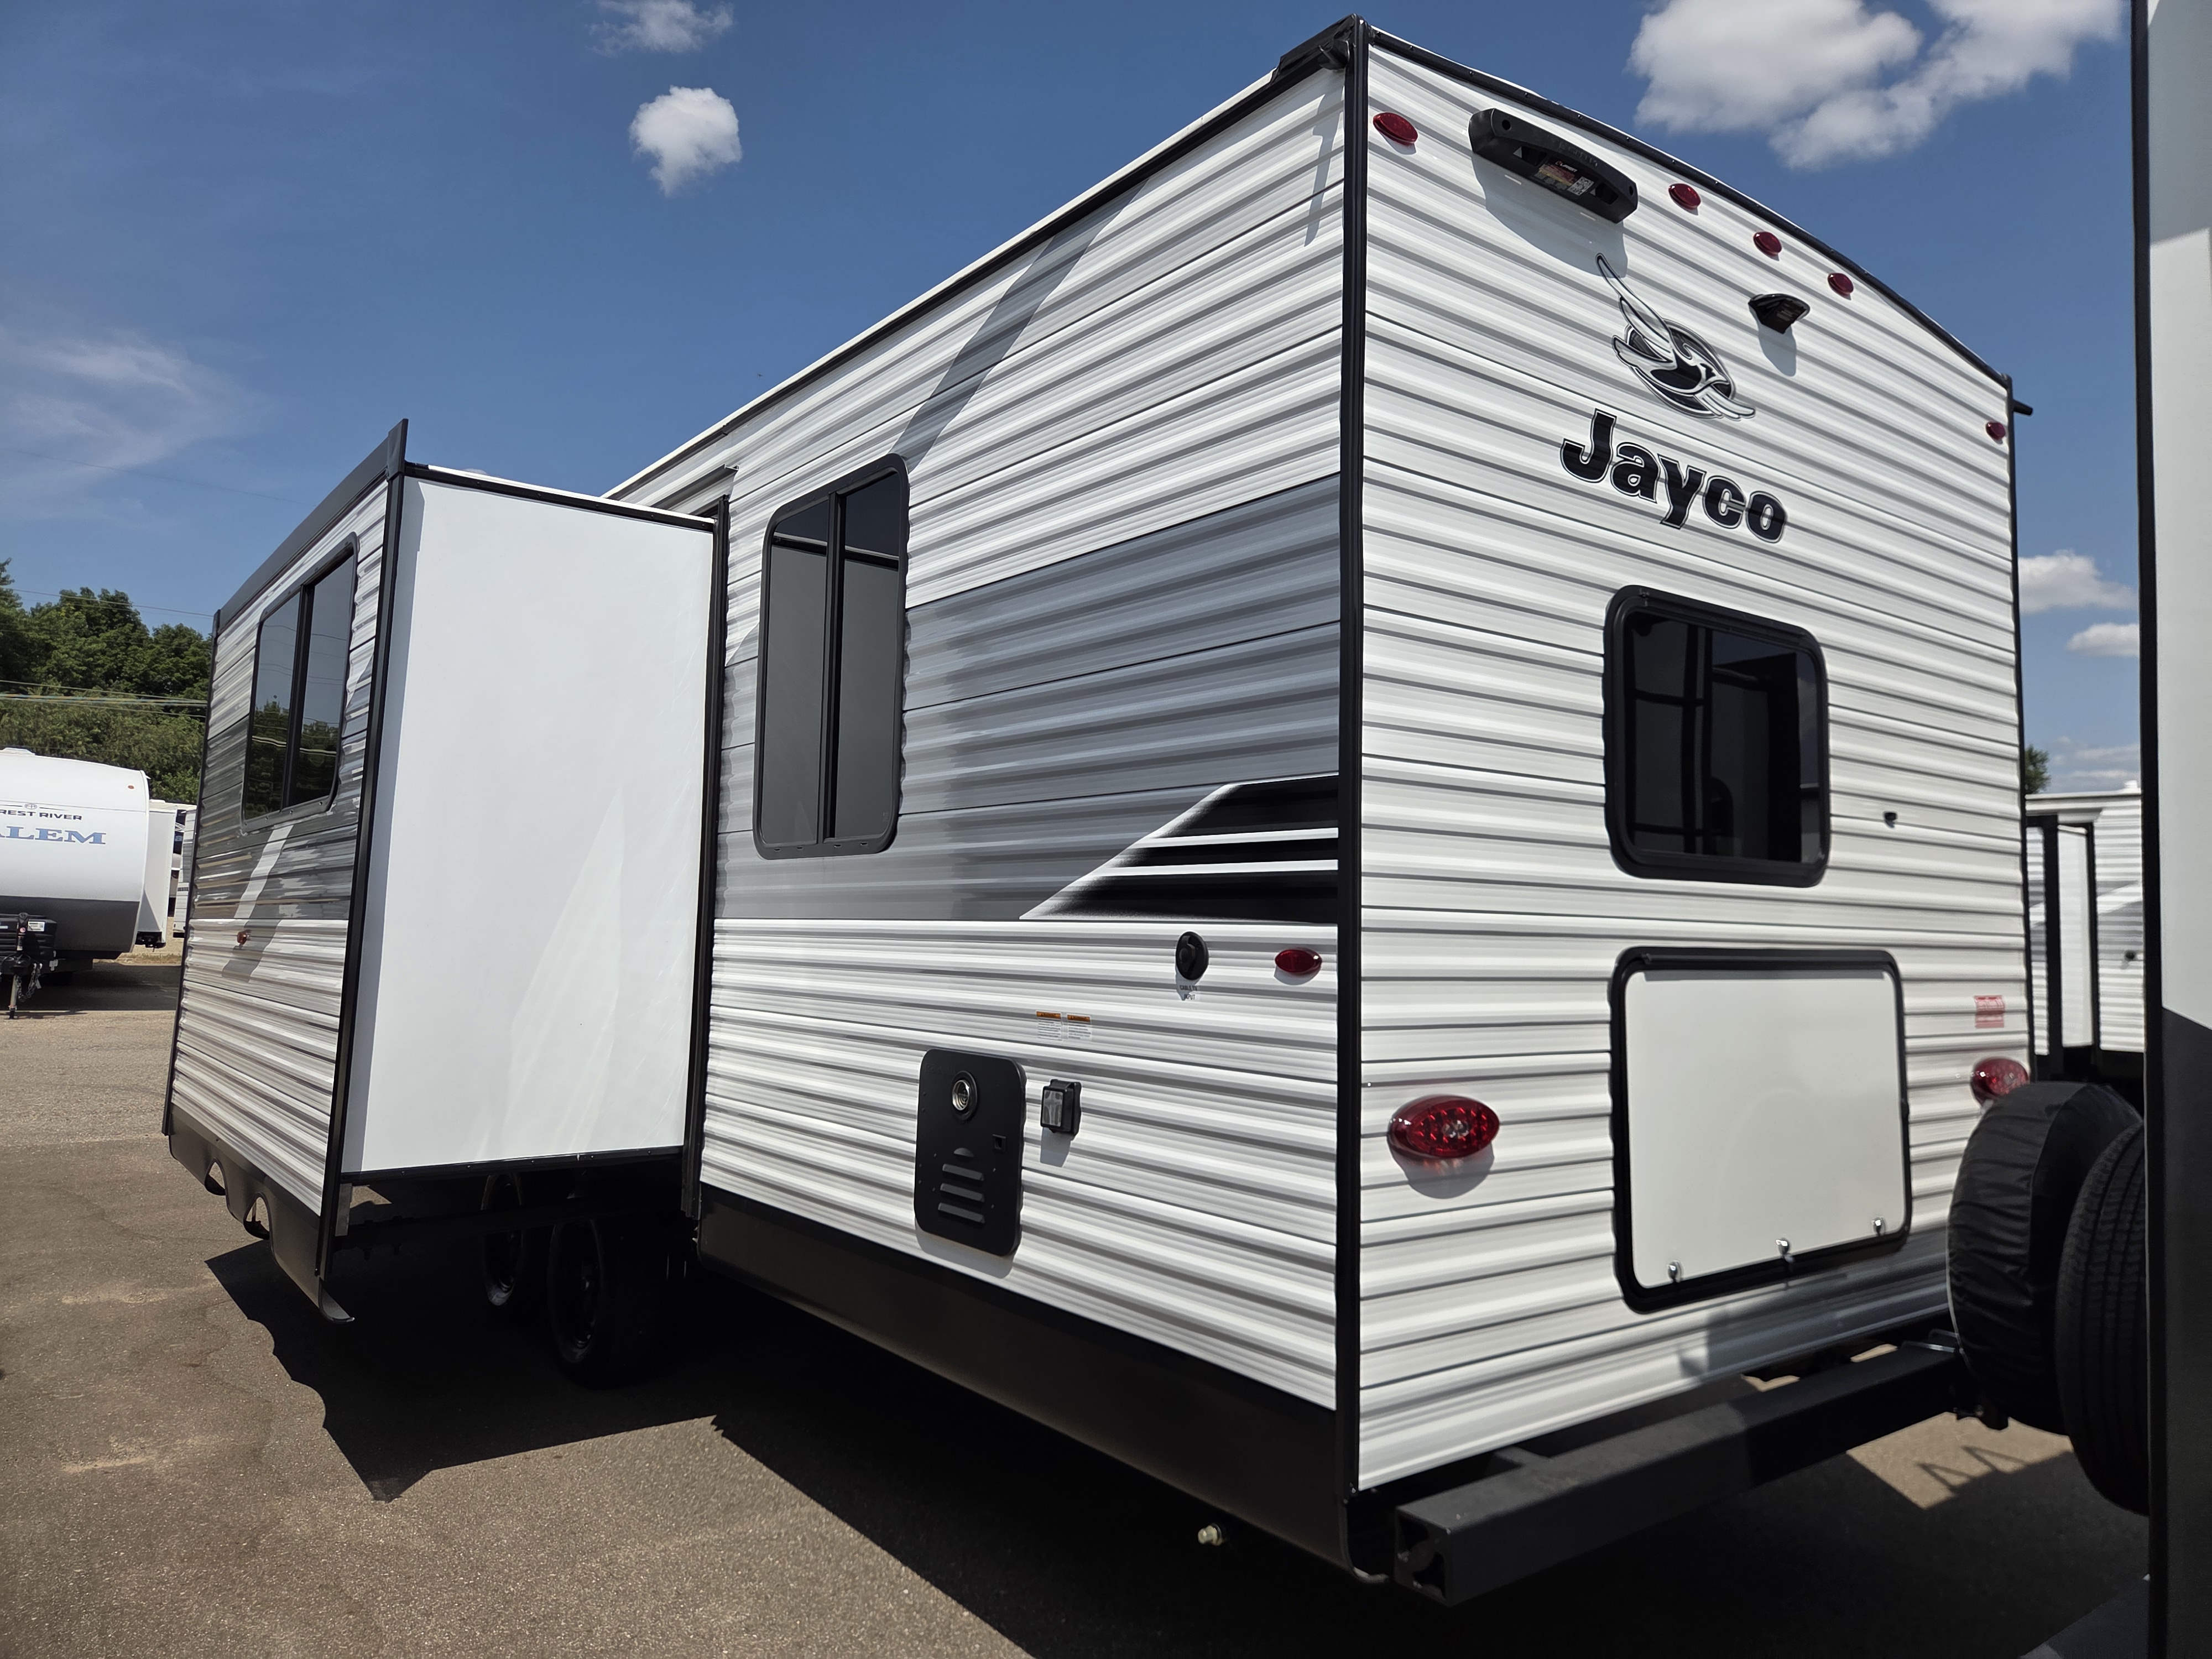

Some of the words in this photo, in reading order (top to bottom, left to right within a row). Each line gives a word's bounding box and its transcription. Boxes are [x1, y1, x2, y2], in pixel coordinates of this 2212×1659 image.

[1559, 408, 1788, 544] Jayco
[39, 812, 82, 821] RIVER
[0, 826, 107, 844] LEM
